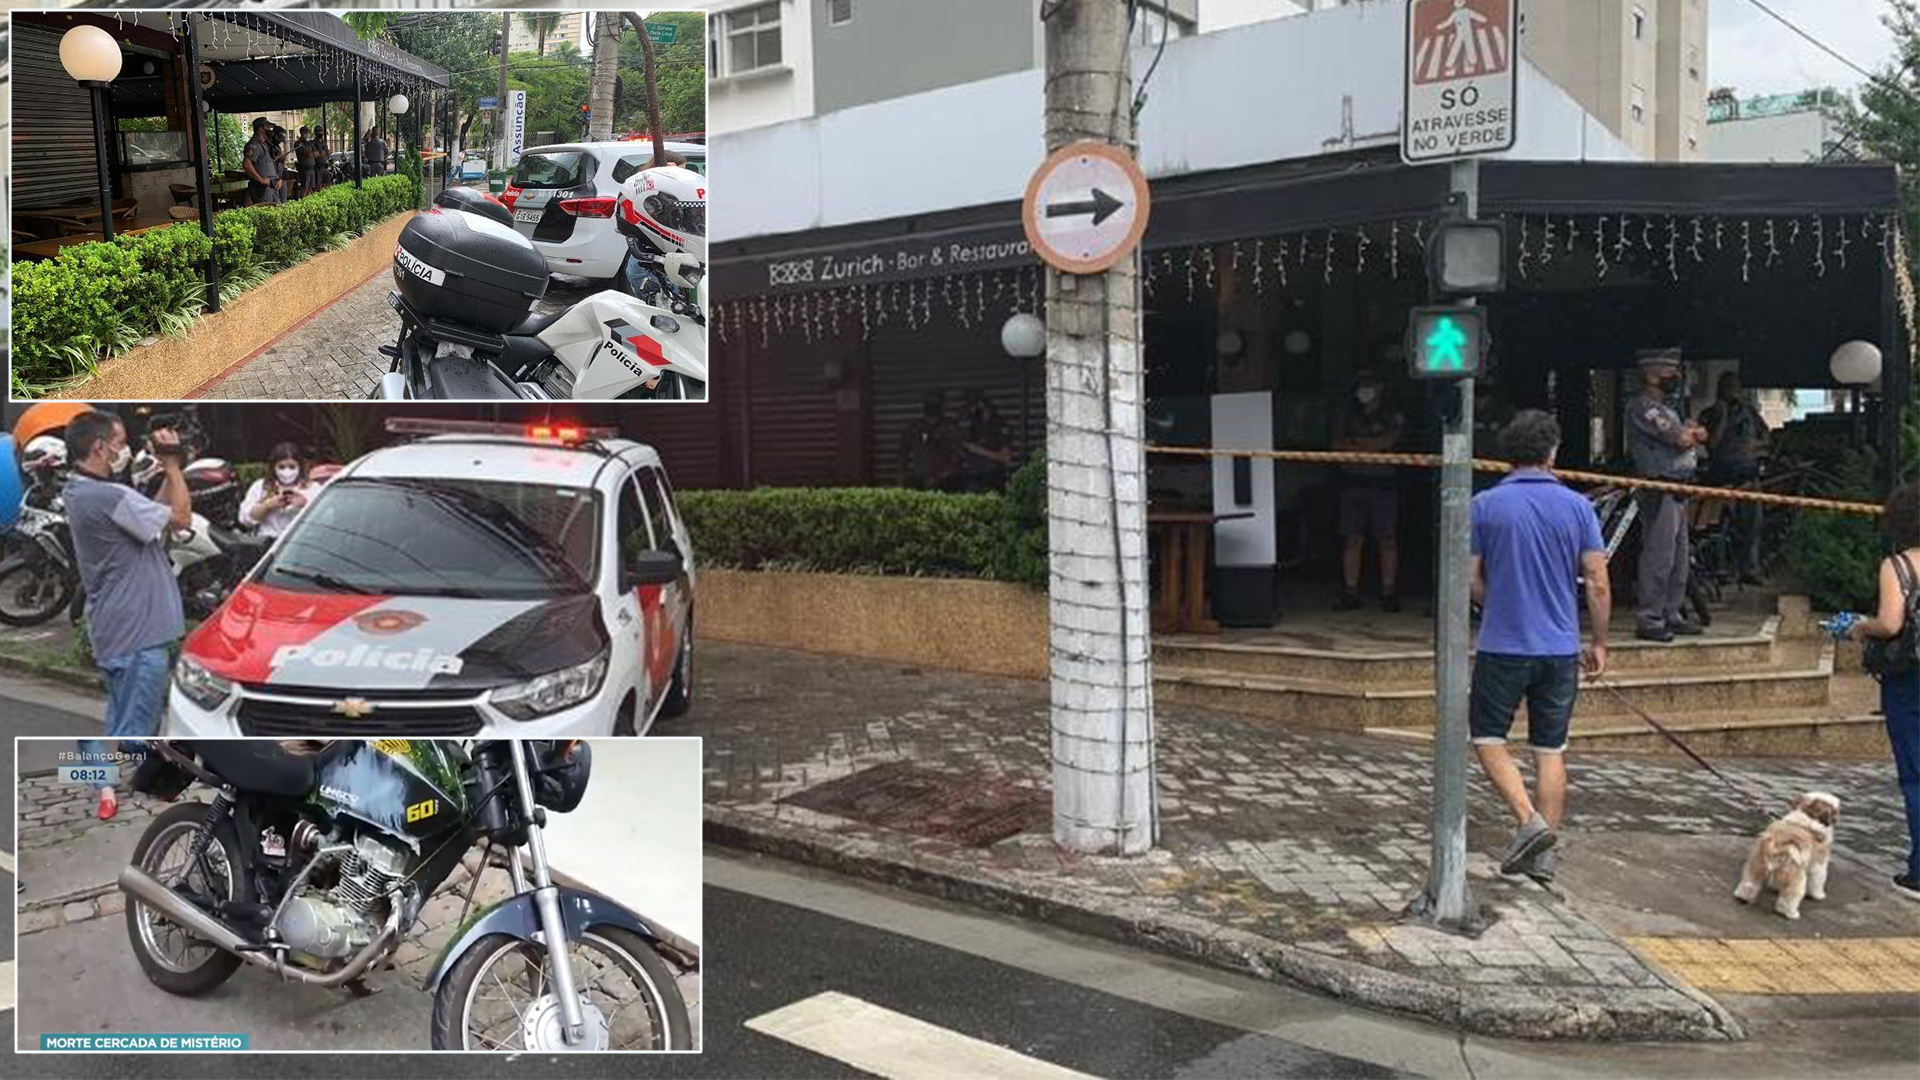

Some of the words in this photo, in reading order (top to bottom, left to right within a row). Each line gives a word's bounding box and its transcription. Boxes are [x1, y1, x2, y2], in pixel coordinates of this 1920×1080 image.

[1440, 81, 1479, 110] SÓ
[513, 93, 525, 155] Assunção
[1412, 108, 1508, 133] ATRAVESSE
[1413, 135, 1438, 151] NO
[1447, 127, 1506, 147] VERDE
[399, 252, 433, 281] POLÍCIA
[821, 254, 884, 280] Zurich
[897, 252, 925, 271] Bar
[931, 248, 943, 266] &
[950, 240, 1032, 264] Restaura
[603, 341, 643, 377] Polícia
[270, 643, 464, 675] Polícia
[406, 799, 434, 823] 60
